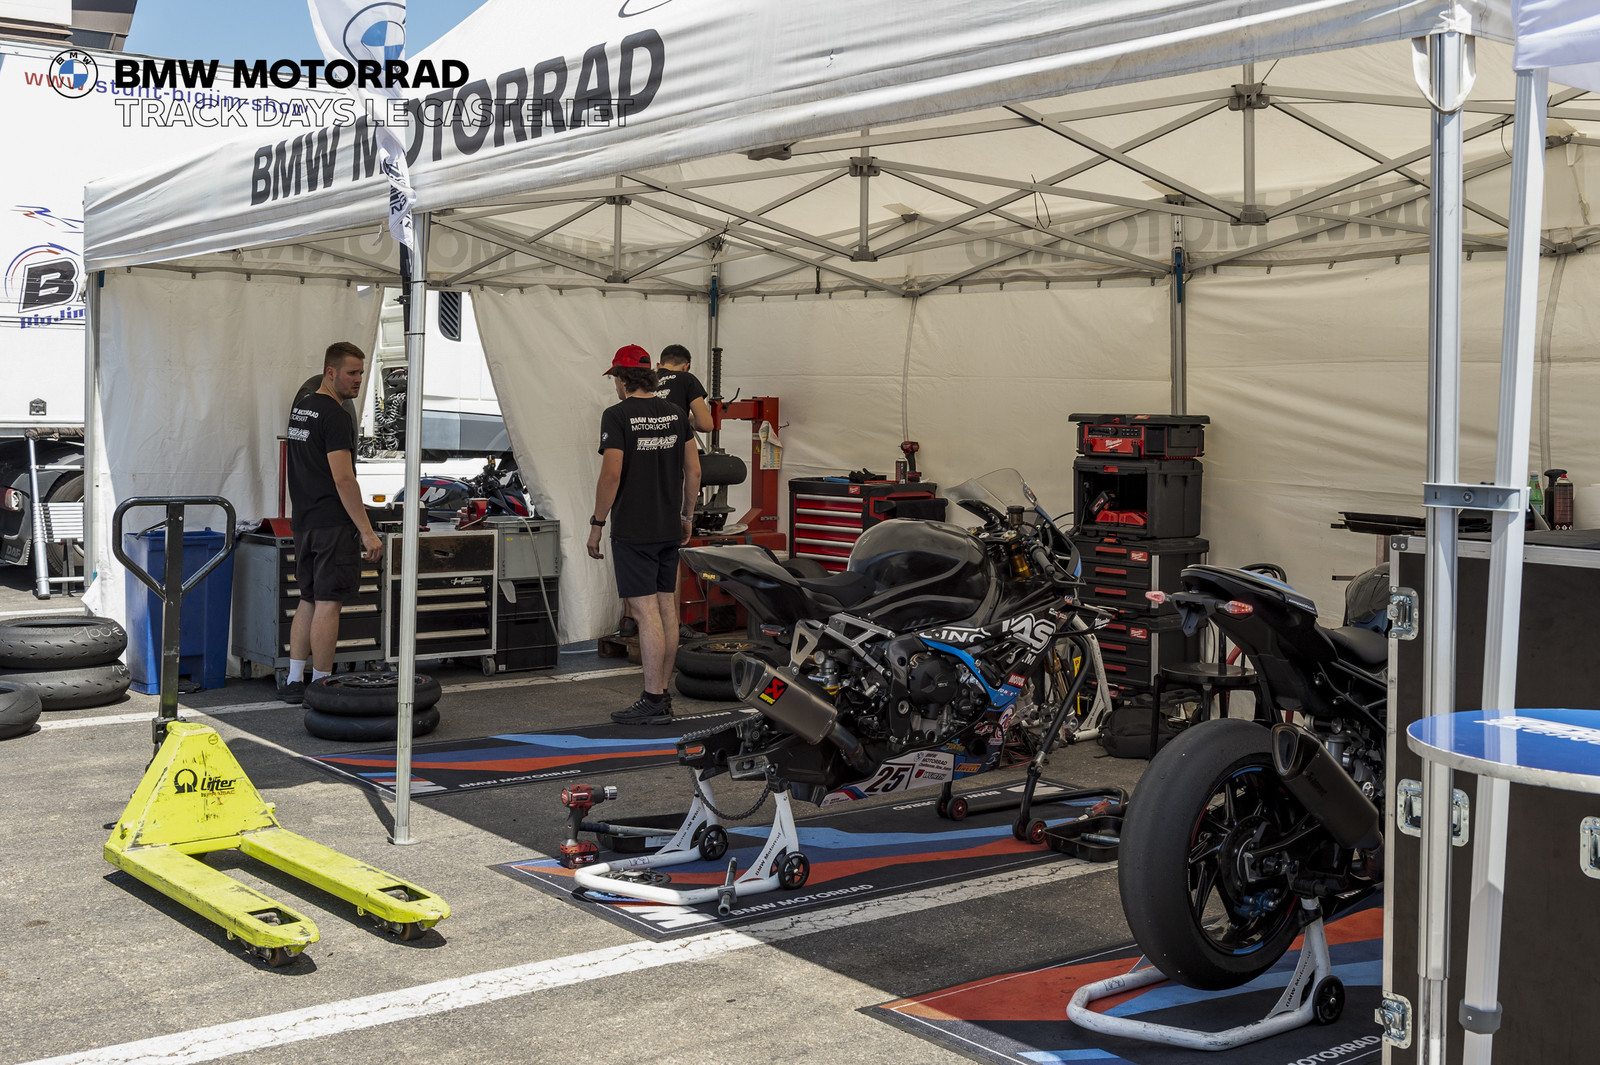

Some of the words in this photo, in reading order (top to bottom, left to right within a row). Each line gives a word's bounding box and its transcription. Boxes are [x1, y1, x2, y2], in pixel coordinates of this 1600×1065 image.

[250, 122, 343, 206] BMW
[864, 766, 911, 793] 25
[729, 902, 777, 916] BMW
[777, 884, 875, 907] MOTORRAD
[1287, 1035, 1382, 1065] OTORRAD
